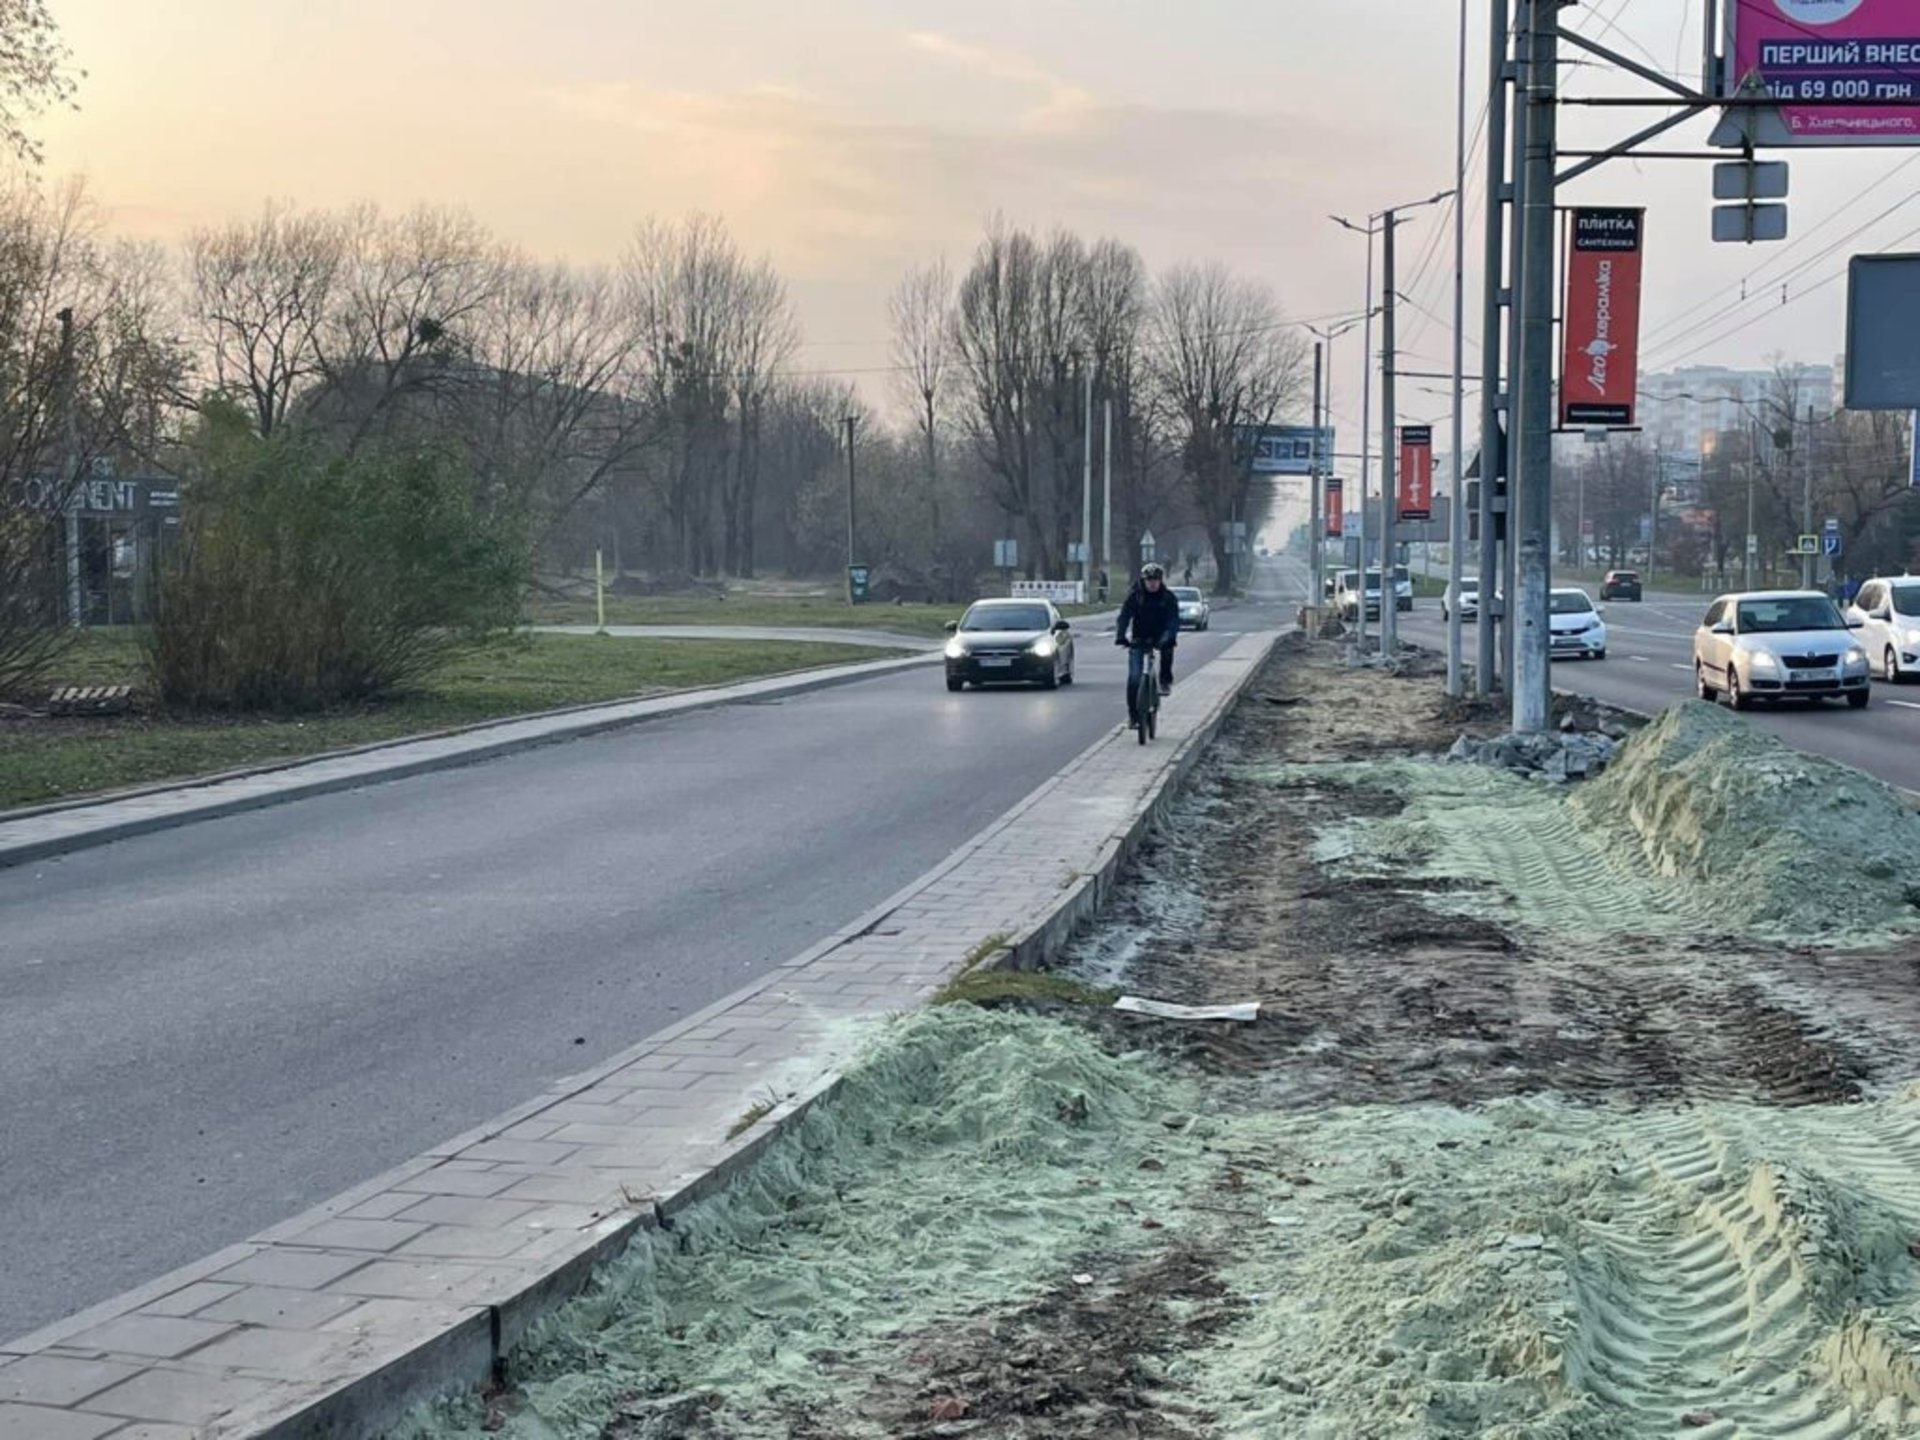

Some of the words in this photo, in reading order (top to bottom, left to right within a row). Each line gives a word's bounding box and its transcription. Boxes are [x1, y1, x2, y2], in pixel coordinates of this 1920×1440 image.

[1763, 41, 1859, 63] ПЕРШИЙ
[1801, 80, 1825, 98] 69
[1832, 79, 1869, 98] 000
[1875, 83, 1911, 98] грн
[1578, 218, 1635, 230] ПЛИТКА
